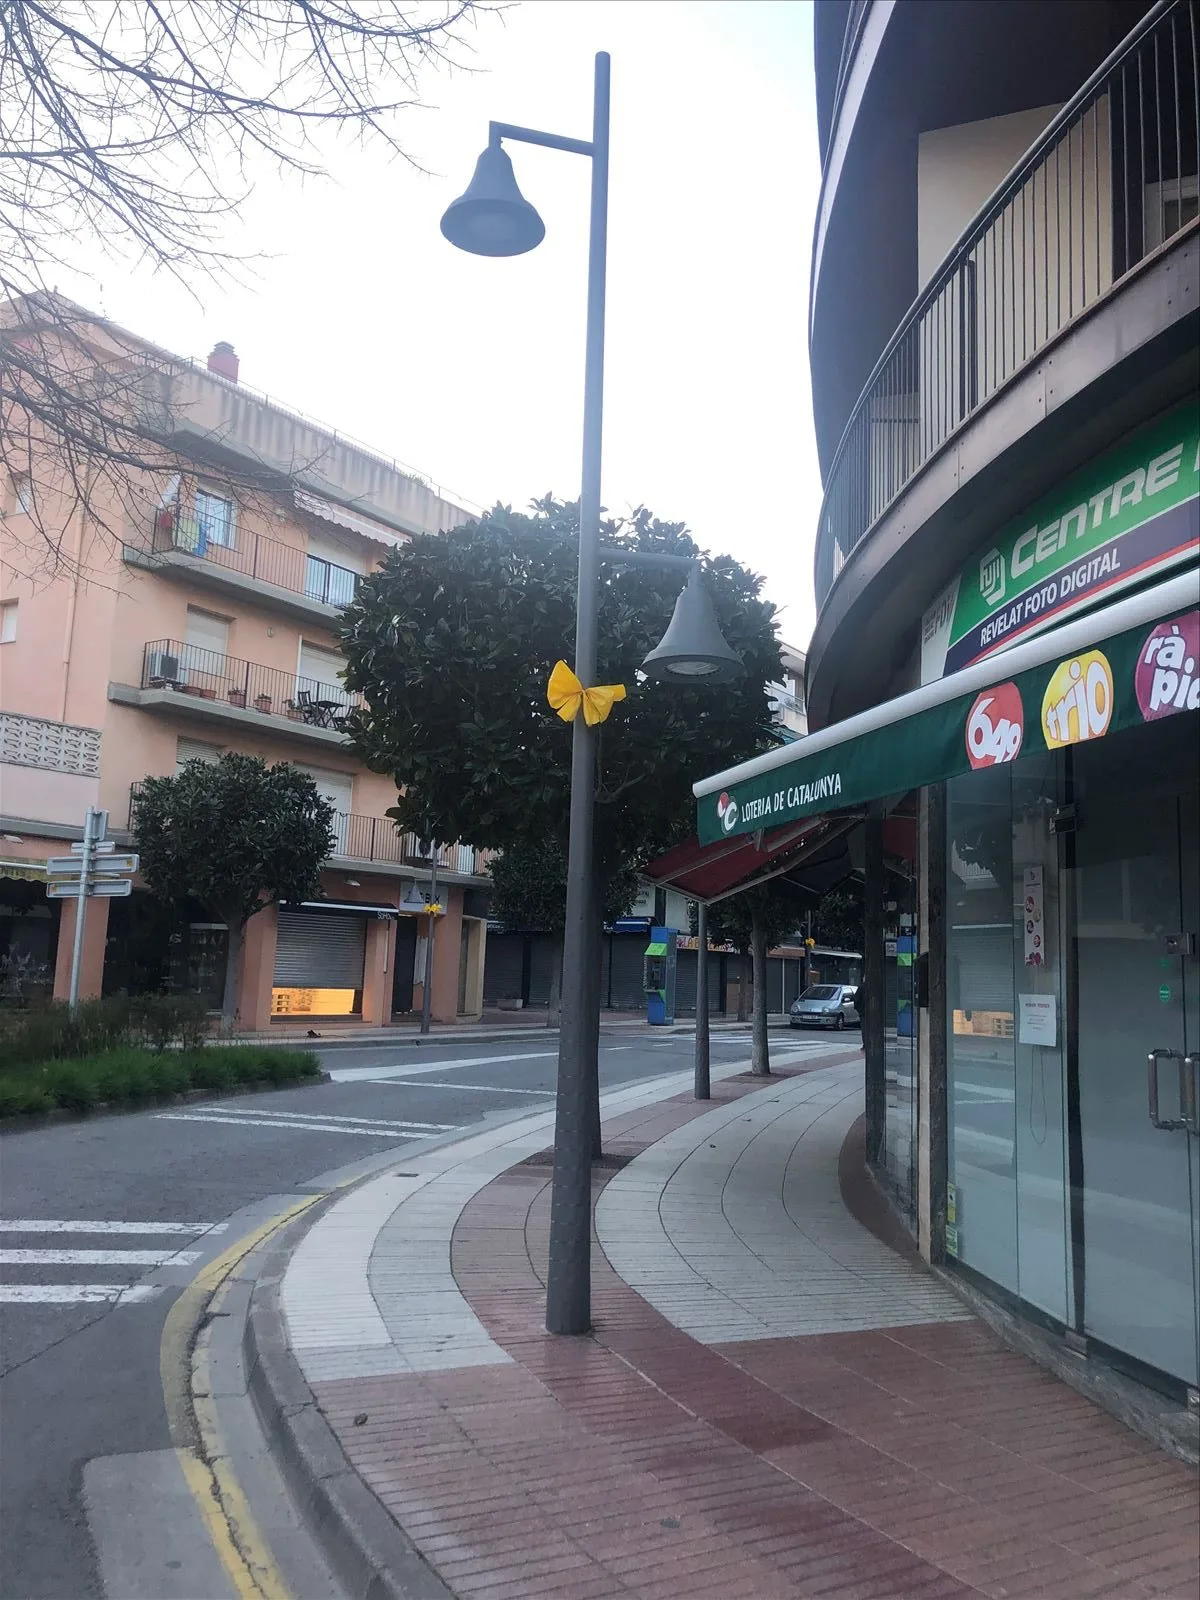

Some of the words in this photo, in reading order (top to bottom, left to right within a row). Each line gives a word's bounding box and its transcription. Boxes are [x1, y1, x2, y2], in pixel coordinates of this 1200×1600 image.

[980, 601, 1023, 648] REVELAT
[1024, 582, 1058, 619] FOTO
[1060, 548, 1121, 598] DIGITAL
[1046, 660, 1111, 742] trio
[741, 795, 772, 823] LOTERIA
[774, 790, 785, 812] DE
[787, 773, 842, 808] CATALUNYA
